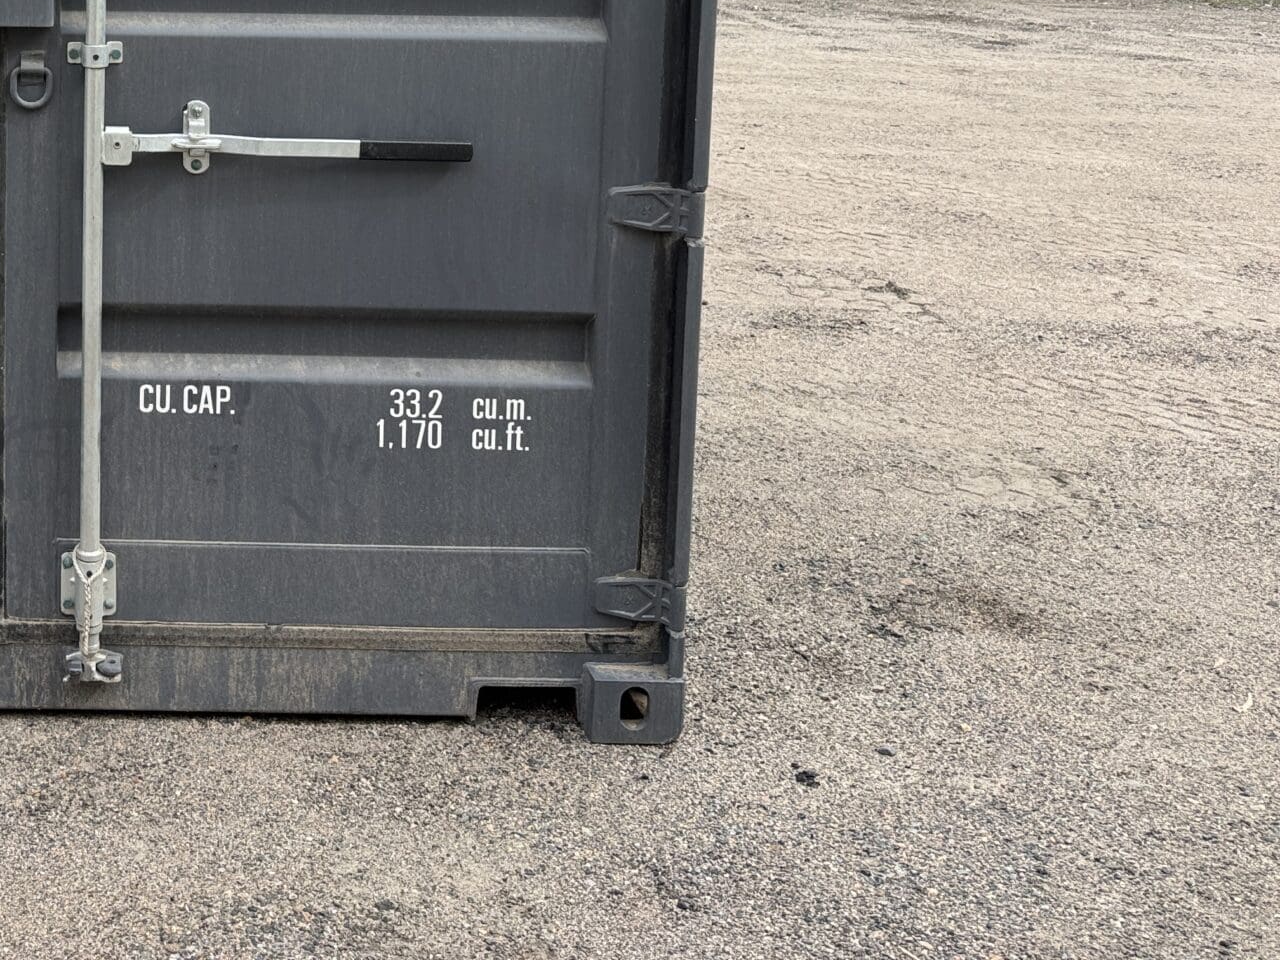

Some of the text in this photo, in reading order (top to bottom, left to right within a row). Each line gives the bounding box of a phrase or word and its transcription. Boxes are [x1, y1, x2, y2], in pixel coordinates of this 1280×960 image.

[139, 384, 236, 415] CU. CAP.
[389, 388, 532, 420] 33.2 cu.m.
[376, 418, 530, 451] 1,170 cu.ft.
